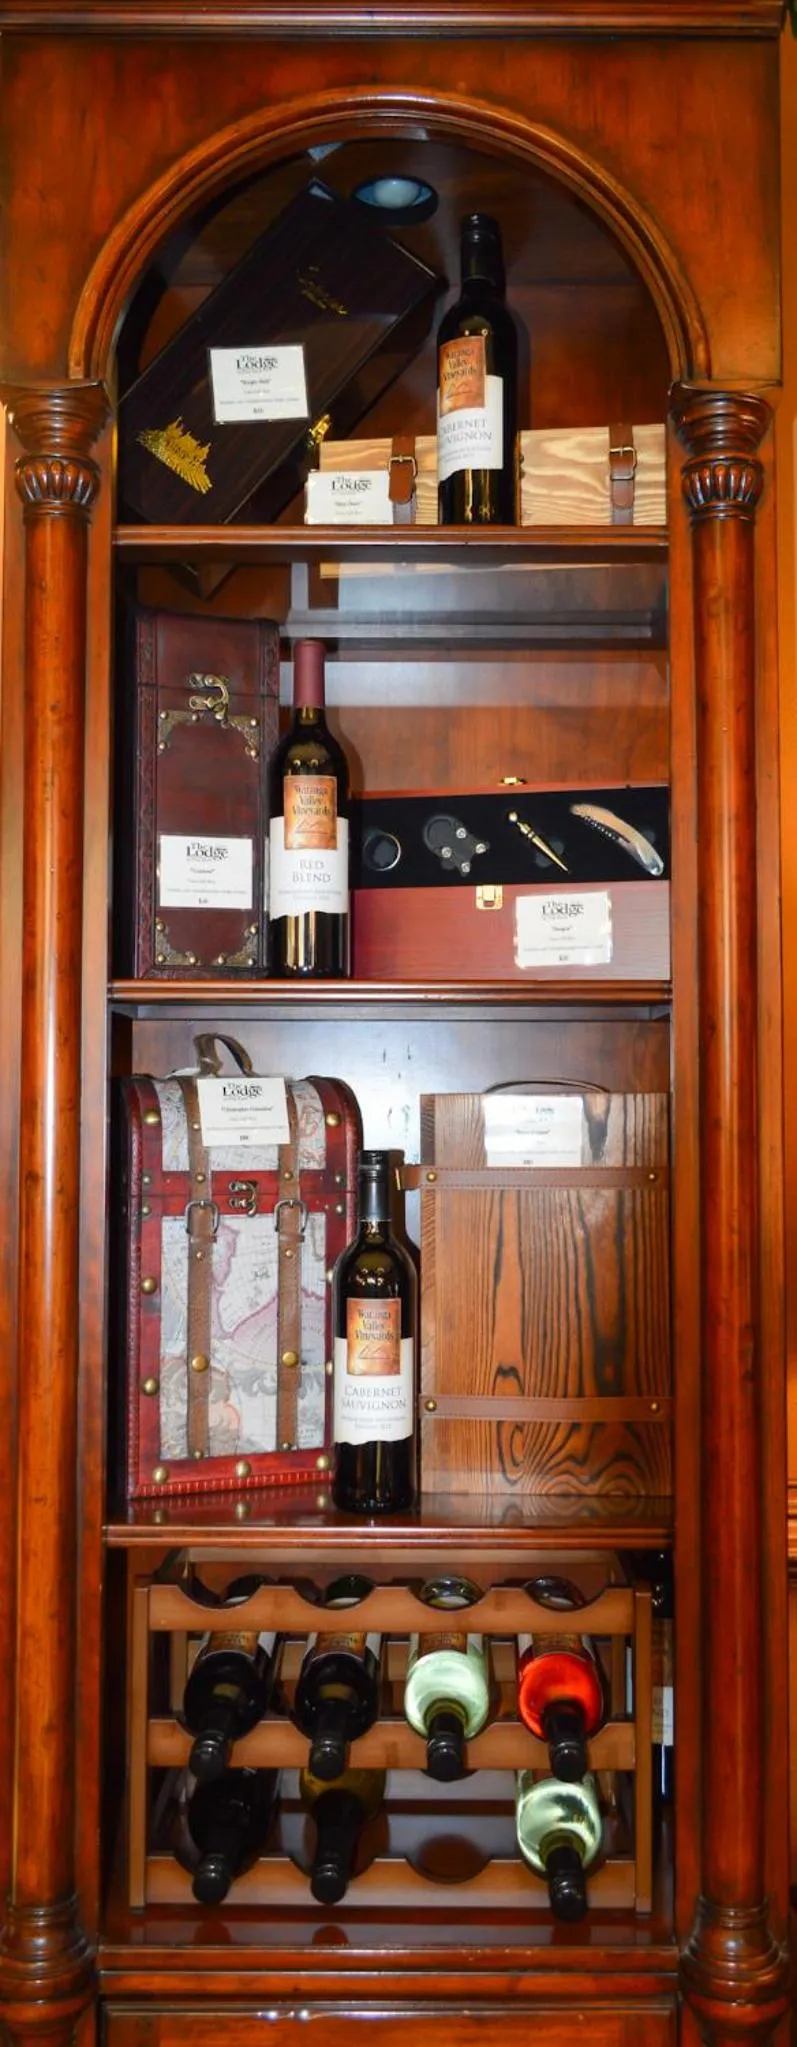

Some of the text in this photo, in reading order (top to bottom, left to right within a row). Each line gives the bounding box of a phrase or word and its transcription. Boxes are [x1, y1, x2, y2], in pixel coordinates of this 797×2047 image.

[235, 357, 279, 371] Lodge
[331, 479, 373, 492] Lodge
[299, 795, 323, 806] Valley
[291, 804, 332, 817] Vineyards
[186, 845, 229, 861] Lodge
[299, 858, 326, 870] RED
[292, 870, 332, 884] BLEND
[541, 903, 584, 918] Lodge
[222, 1085, 263, 1099] Lodge
[362, 1319, 385, 1331] Valley
[354, 1328, 394, 1342] Vineyards
[344, 1385, 402, 1398] CABERNET
[341, 1397, 407, 1411] SAUVIGNON
